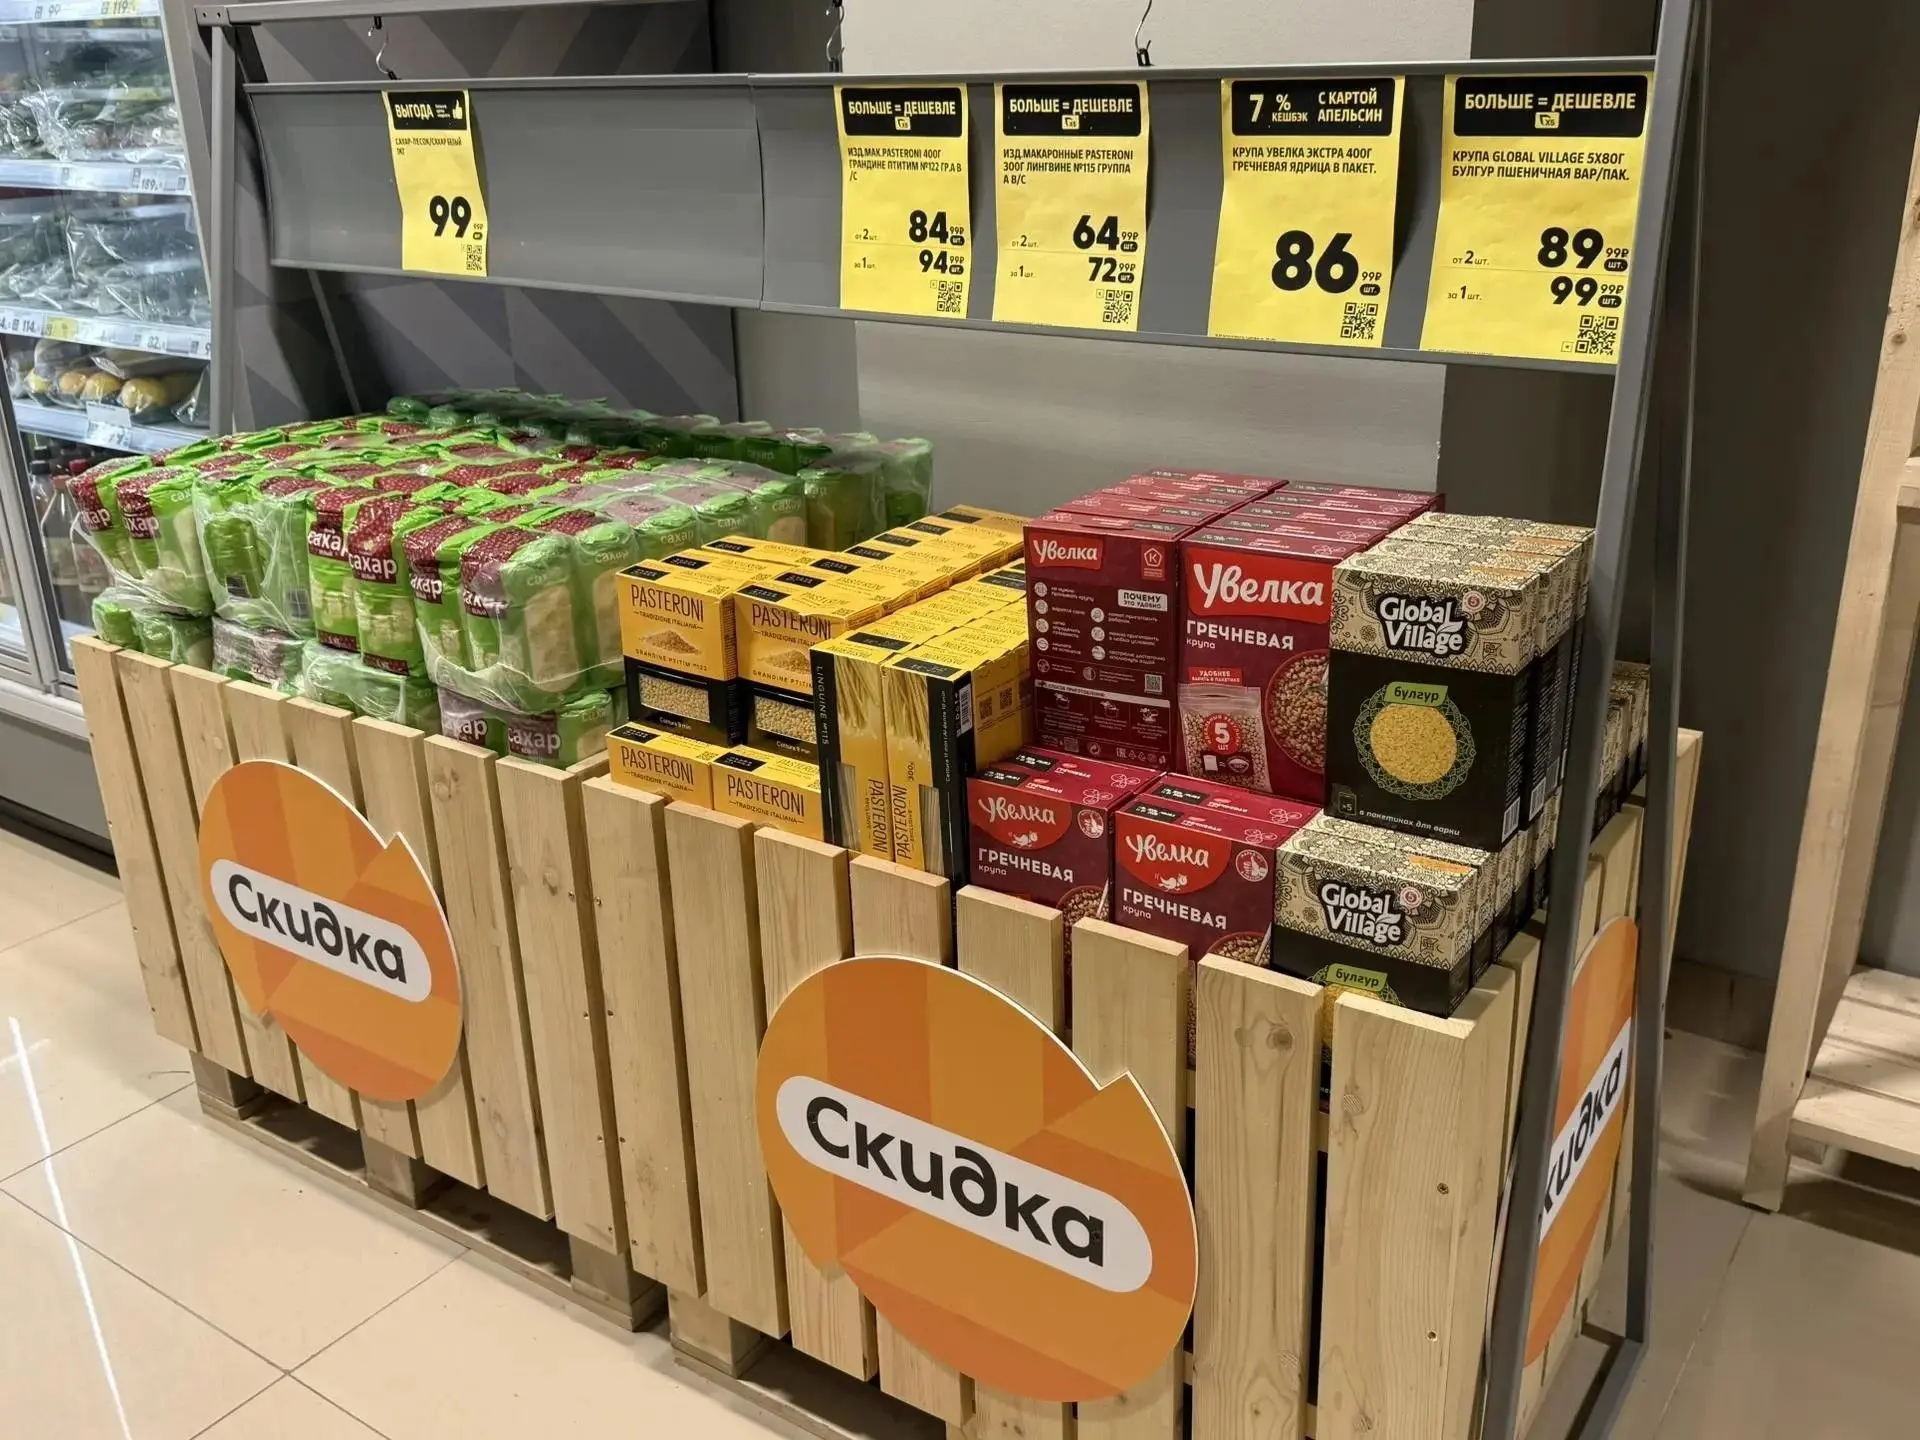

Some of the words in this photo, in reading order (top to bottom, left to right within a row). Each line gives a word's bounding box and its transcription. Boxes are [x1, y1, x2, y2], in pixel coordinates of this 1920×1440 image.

[1010, 99, 1060, 113] БОЛЬШЕ
[1072, 98, 1133, 116] ДЕШЕВЛЕ
[1318, 92, 1326, 104] С
[1328, 87, 1378, 105] КАРТОЙ
[1465, 94, 1534, 109] БОЛЬШЕ
[1552, 93, 1637, 112] ДЕШЕВЛЕ
[395, 103, 434, 120] ВЫГОДА
[848, 101, 893, 114] БОЛЬШЕ
[903, 101, 956, 117] ДЕШЕВЛЕ
[1249, 94, 1265, 123] 7
[1275, 94, 1292, 111] %
[1271, 112, 1308, 122] КЕШБЭК
[1318, 108, 1382, 122] АПЕЛЬСИН
[923, 149, 941, 158] 400Г
[1003, 149, 1083, 160] ИЗД.МАКАРОННЫЕ
[1085, 150, 1133, 160] PASTERONI
[1232, 147, 1264, 158] КРУПА
[1266, 147, 1304, 158] УВЕЛКА
[1307, 148, 1344, 159] ЭКСТРА
[1346, 148, 1372, 159] 400Г
[1453, 151, 1489, 162] КРУПА
[1492, 151, 1535, 163] GLOBAL
[1538, 152, 1584, 164] VILLAGE
[849, 160, 885, 171] ГРАНДИНЕ
[887, 160, 919, 171] ПТИТИМ
[1003, 162, 1024, 172] 300Г
[1026, 162, 1071, 173] ЛИНГВИНЕ
[1073, 163, 1095, 173] №115
[1097, 163, 1131, 174] ГРУППА
[1232, 161, 1287, 172] ГРЕЧНЕВАЯ
[1289, 162, 1331, 175] ЯДРИЦА
[1333, 163, 1340, 173] В
[1342, 163, 1377, 174] ПАКЕТ.
[1452, 166, 1494, 177] БУЛГУР
[1497, 166, 1571, 179] ПШЕНИЧНАЯ
[1574, 168, 1629, 181] ВАР/ПАК.
[1003, 175, 1010, 184] А
[1011, 175, 1027, 185] В/С
[430, 195, 472, 238] 99
[909, 210, 949, 244] 84
[863, 229, 869, 240] 2
[1020, 235, 1028, 247] 2
[1073, 215, 1120, 250] 64
[1465, 250, 1473, 264] 2
[1538, 227, 1603, 269] 89
[862, 257, 867, 269] 1
[919, 249, 948, 274] 94
[1019, 266, 1024, 277] 1
[1088, 257, 1118, 282] 72
[1271, 230, 1359, 294] 86
[1460, 285, 1467, 299] 1
[1550, 276, 1598, 306] 99
[1033, 539, 1098, 563] Увелка
[348, 552, 398, 580] сахар
[1124, 592, 1161, 603] ПОЧЕМУ
[1193, 563, 1324, 608] Увелка
[631, 584, 704, 622] PASTERONI
[1379, 596, 1456, 626] Global
[639, 611, 671, 624] TRADIZIONE
[752, 603, 831, 639] PASTERONI
[1186, 620, 1294, 650] ГРЕЧНЕВАЯ
[1186, 638, 1216, 649] крупа
[1385, 620, 1463, 654] Village
[817, 666, 826, 719] LINGUINE
[1394, 685, 1440, 704] булгур
[1214, 722, 1231, 744] 5
[620, 745, 694, 785] PASTERONI
[727, 774, 804, 817] PASTERONI
[868, 778, 888, 853] PASTERONI
[892, 784, 912, 860] PASTERONI
[978, 796, 1056, 825] Увелка
[1366, 811, 1413, 826] пакетиках
[1415, 821, 1431, 830] для
[1433, 825, 1461, 836] варки
[1125, 834, 1210, 869] Увелка
[978, 847, 1074, 884] ГРЕЧНЕВАЯ
[978, 863, 1007, 876] крупа
[1123, 887, 1227, 930] ГРЕЧНЕВАЯ
[1321, 883, 1391, 914] Global
[1122, 904, 1152, 919] крупа
[228, 874, 407, 984] Скидка
[1327, 905, 1401, 944] Village
[1335, 967, 1379, 988] булгур
[806, 1096, 1104, 1268] Скидка
